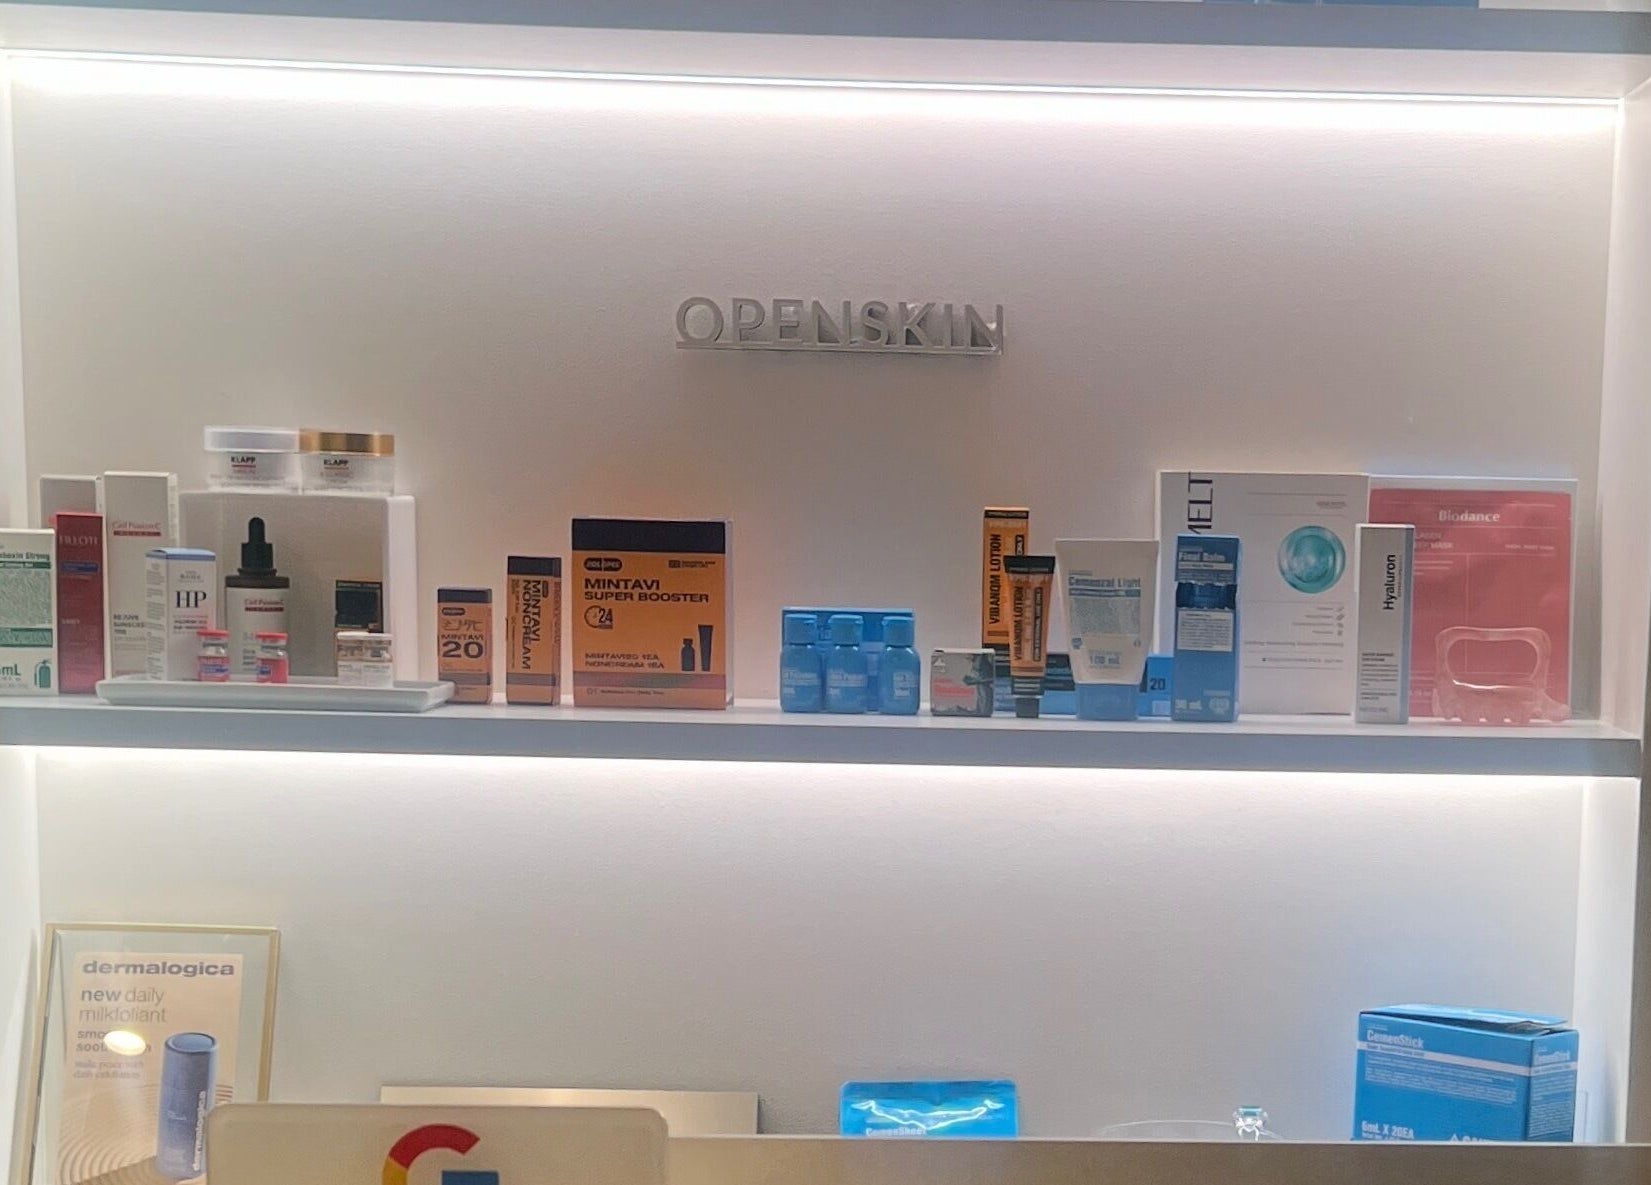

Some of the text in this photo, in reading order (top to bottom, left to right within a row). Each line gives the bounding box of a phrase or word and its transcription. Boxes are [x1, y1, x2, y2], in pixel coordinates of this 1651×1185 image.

[676, 296, 1004, 352] OPENSKIN
[231, 456, 256, 464] KLAPP
[1438, 510, 1500, 522] Biodance
[990, 534, 1002, 572] LOTION
[584, 578, 660, 590] MINTAVI
[1383, 554, 1397, 610] Hyaluron
[175, 590, 207, 608] HP
[584, 591, 709, 603] SUPER BOOSTER
[1013, 586, 1024, 618] LOTION
[532, 580, 541, 641] MINTAVI
[598, 607, 613, 623] 24
[522, 580, 532, 670] NONCREAM
[442, 640, 484, 659] 20
[0, 663, 21, 676] mL
[1150, 678, 1166, 690] 20
[83, 960, 235, 977] dermalogica
[81, 987, 165, 1006] new daily
[78, 1008, 167, 1023] milkfoliant
[1382, 1124, 1389, 1135] X
